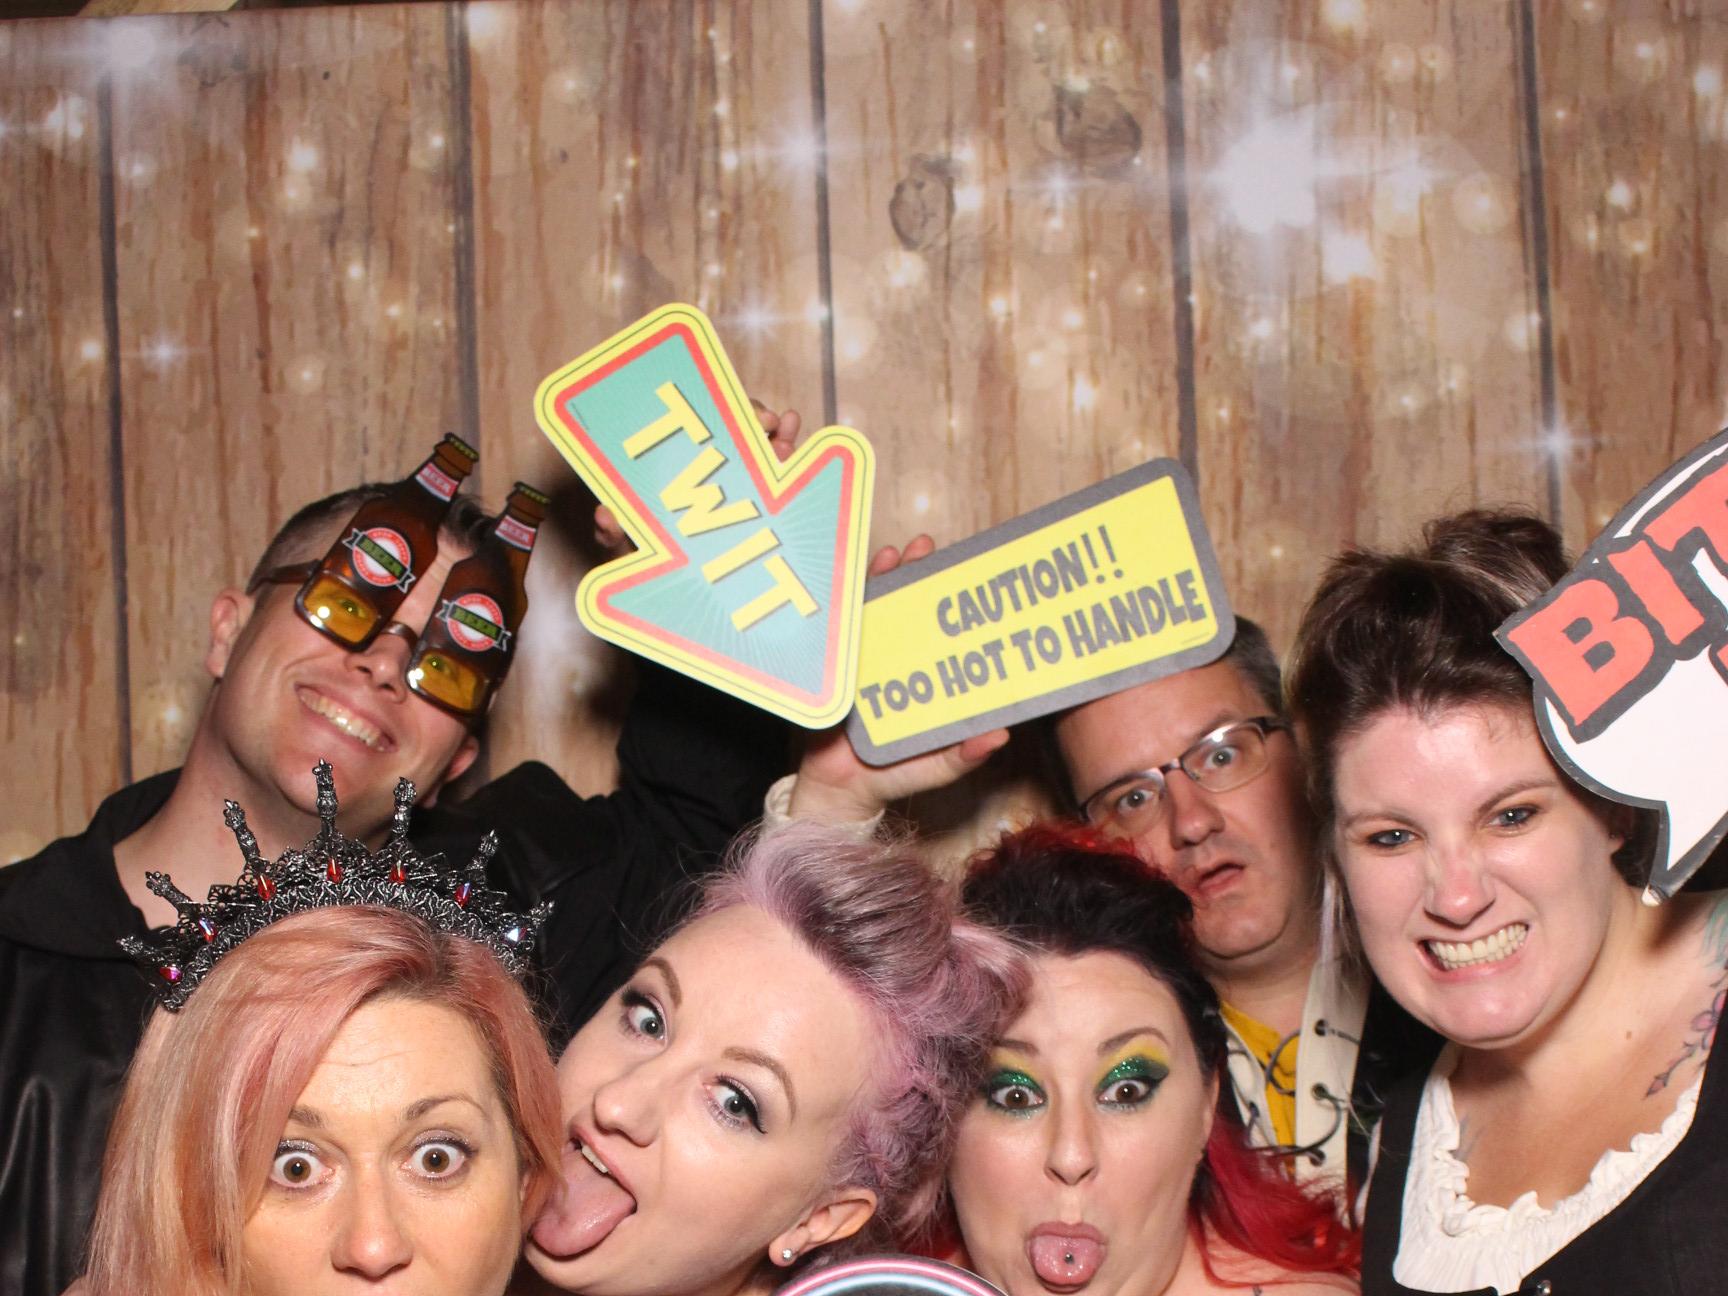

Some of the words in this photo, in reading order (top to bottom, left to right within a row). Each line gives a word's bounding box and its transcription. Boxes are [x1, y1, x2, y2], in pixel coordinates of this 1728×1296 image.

[620, 381, 821, 634] TWIT
[936, 524, 1125, 638] CAUTION!!
[862, 671, 934, 719] TOO
[936, 643, 1010, 699] HOT
[1011, 623, 1062, 670] TO
[1061, 569, 1206, 657] HANDLE
